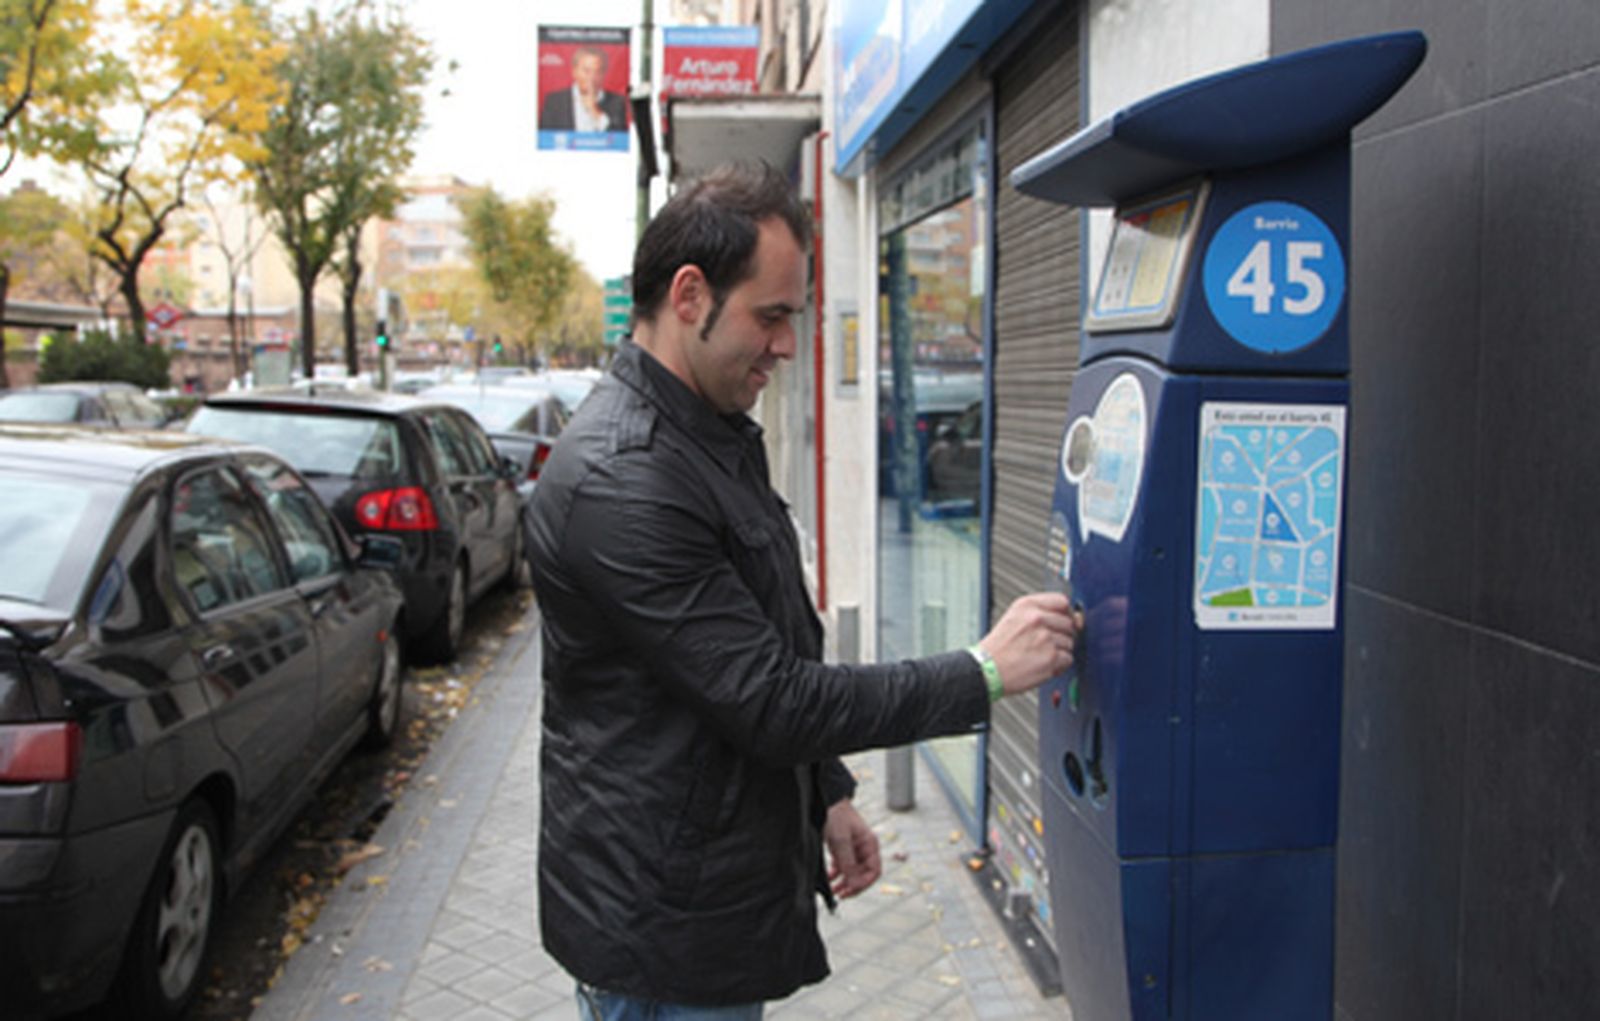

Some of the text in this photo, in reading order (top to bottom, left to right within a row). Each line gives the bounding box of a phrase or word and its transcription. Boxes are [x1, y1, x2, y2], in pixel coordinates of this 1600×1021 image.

[679, 56, 740, 75] Arturo
[1254, 216, 1300, 230] Barrio
[1226, 239, 1326, 316] 45
